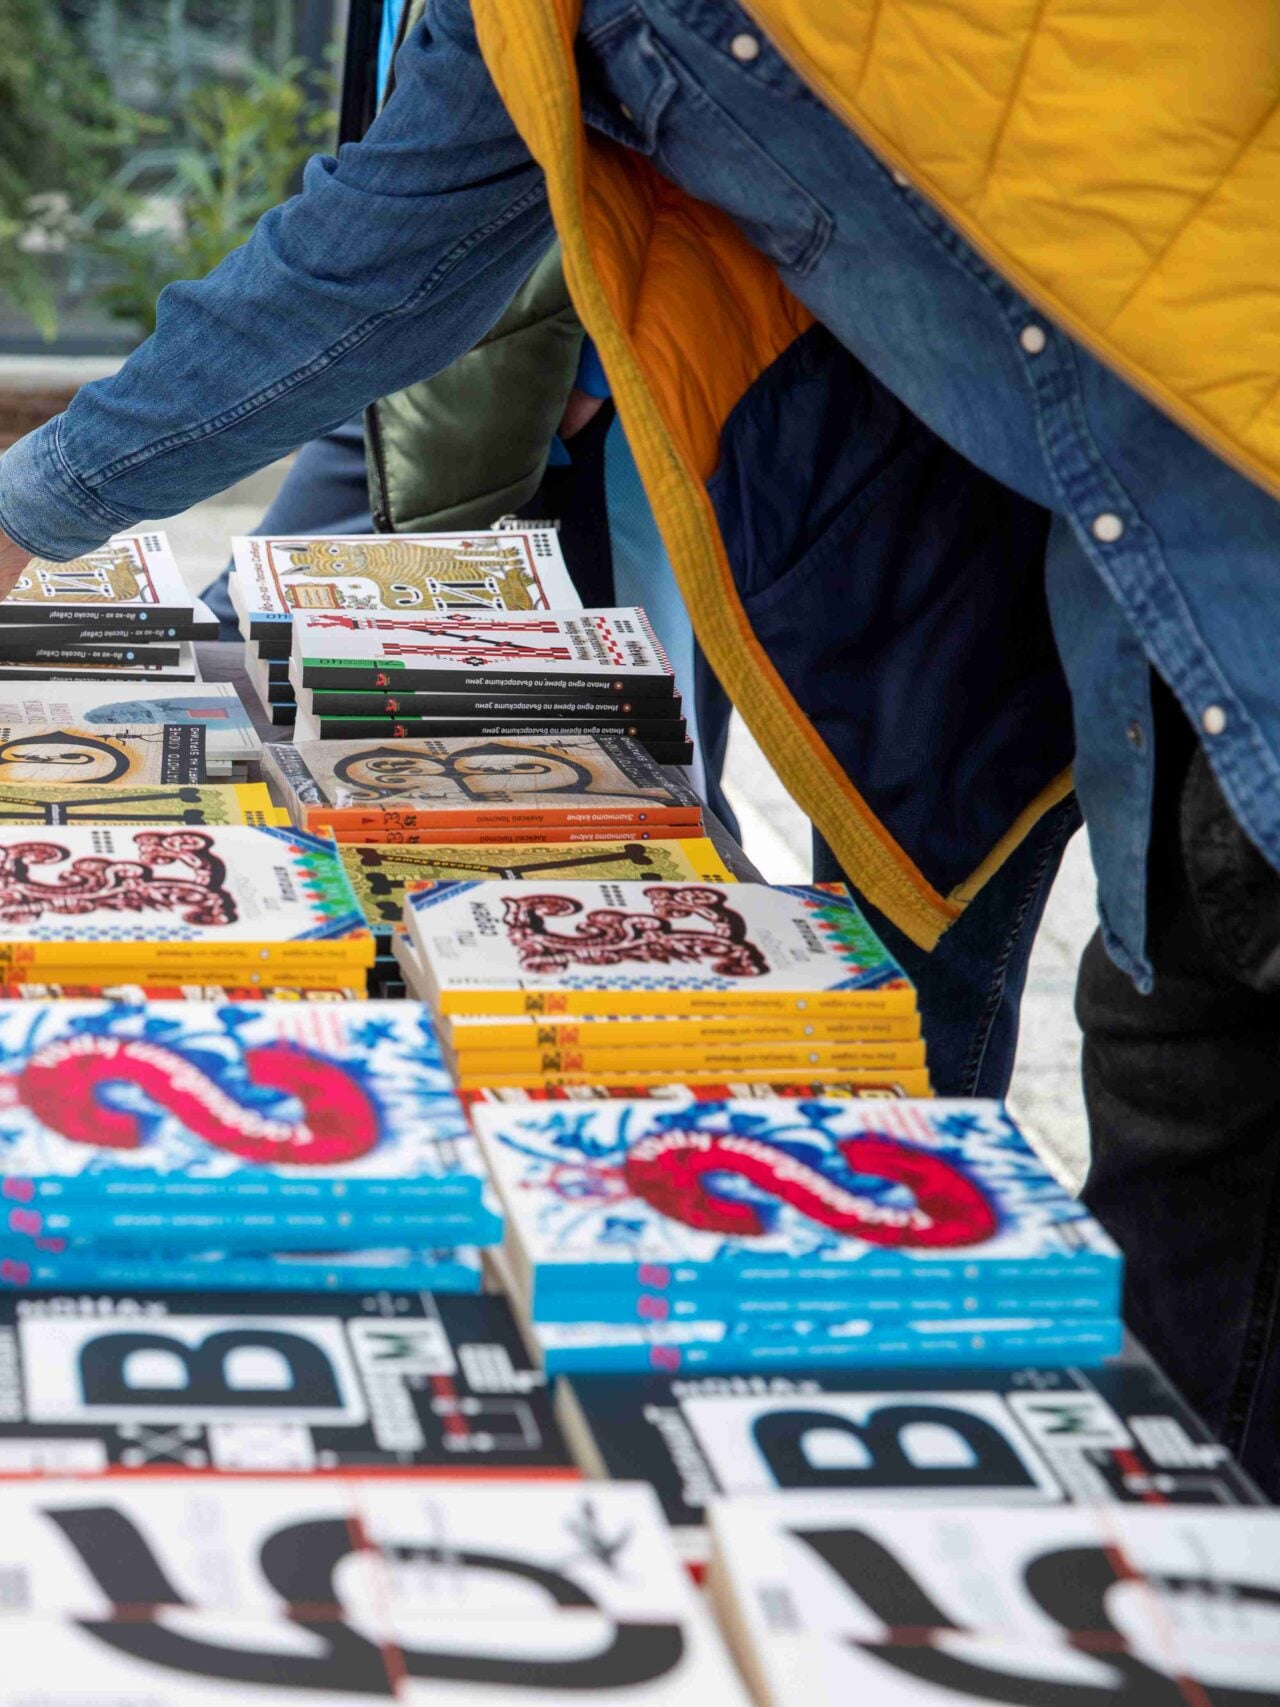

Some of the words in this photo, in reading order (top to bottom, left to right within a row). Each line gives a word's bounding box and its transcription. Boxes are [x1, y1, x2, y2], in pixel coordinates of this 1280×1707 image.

[485, 679, 533, 687] българските
[167, 727, 182, 750] КЛЮЧЕ
[186, 727, 200, 756] БУРАТИНО
[164, 754, 182, 785] ЛАТНОТО
[187, 758, 199, 766] НА
